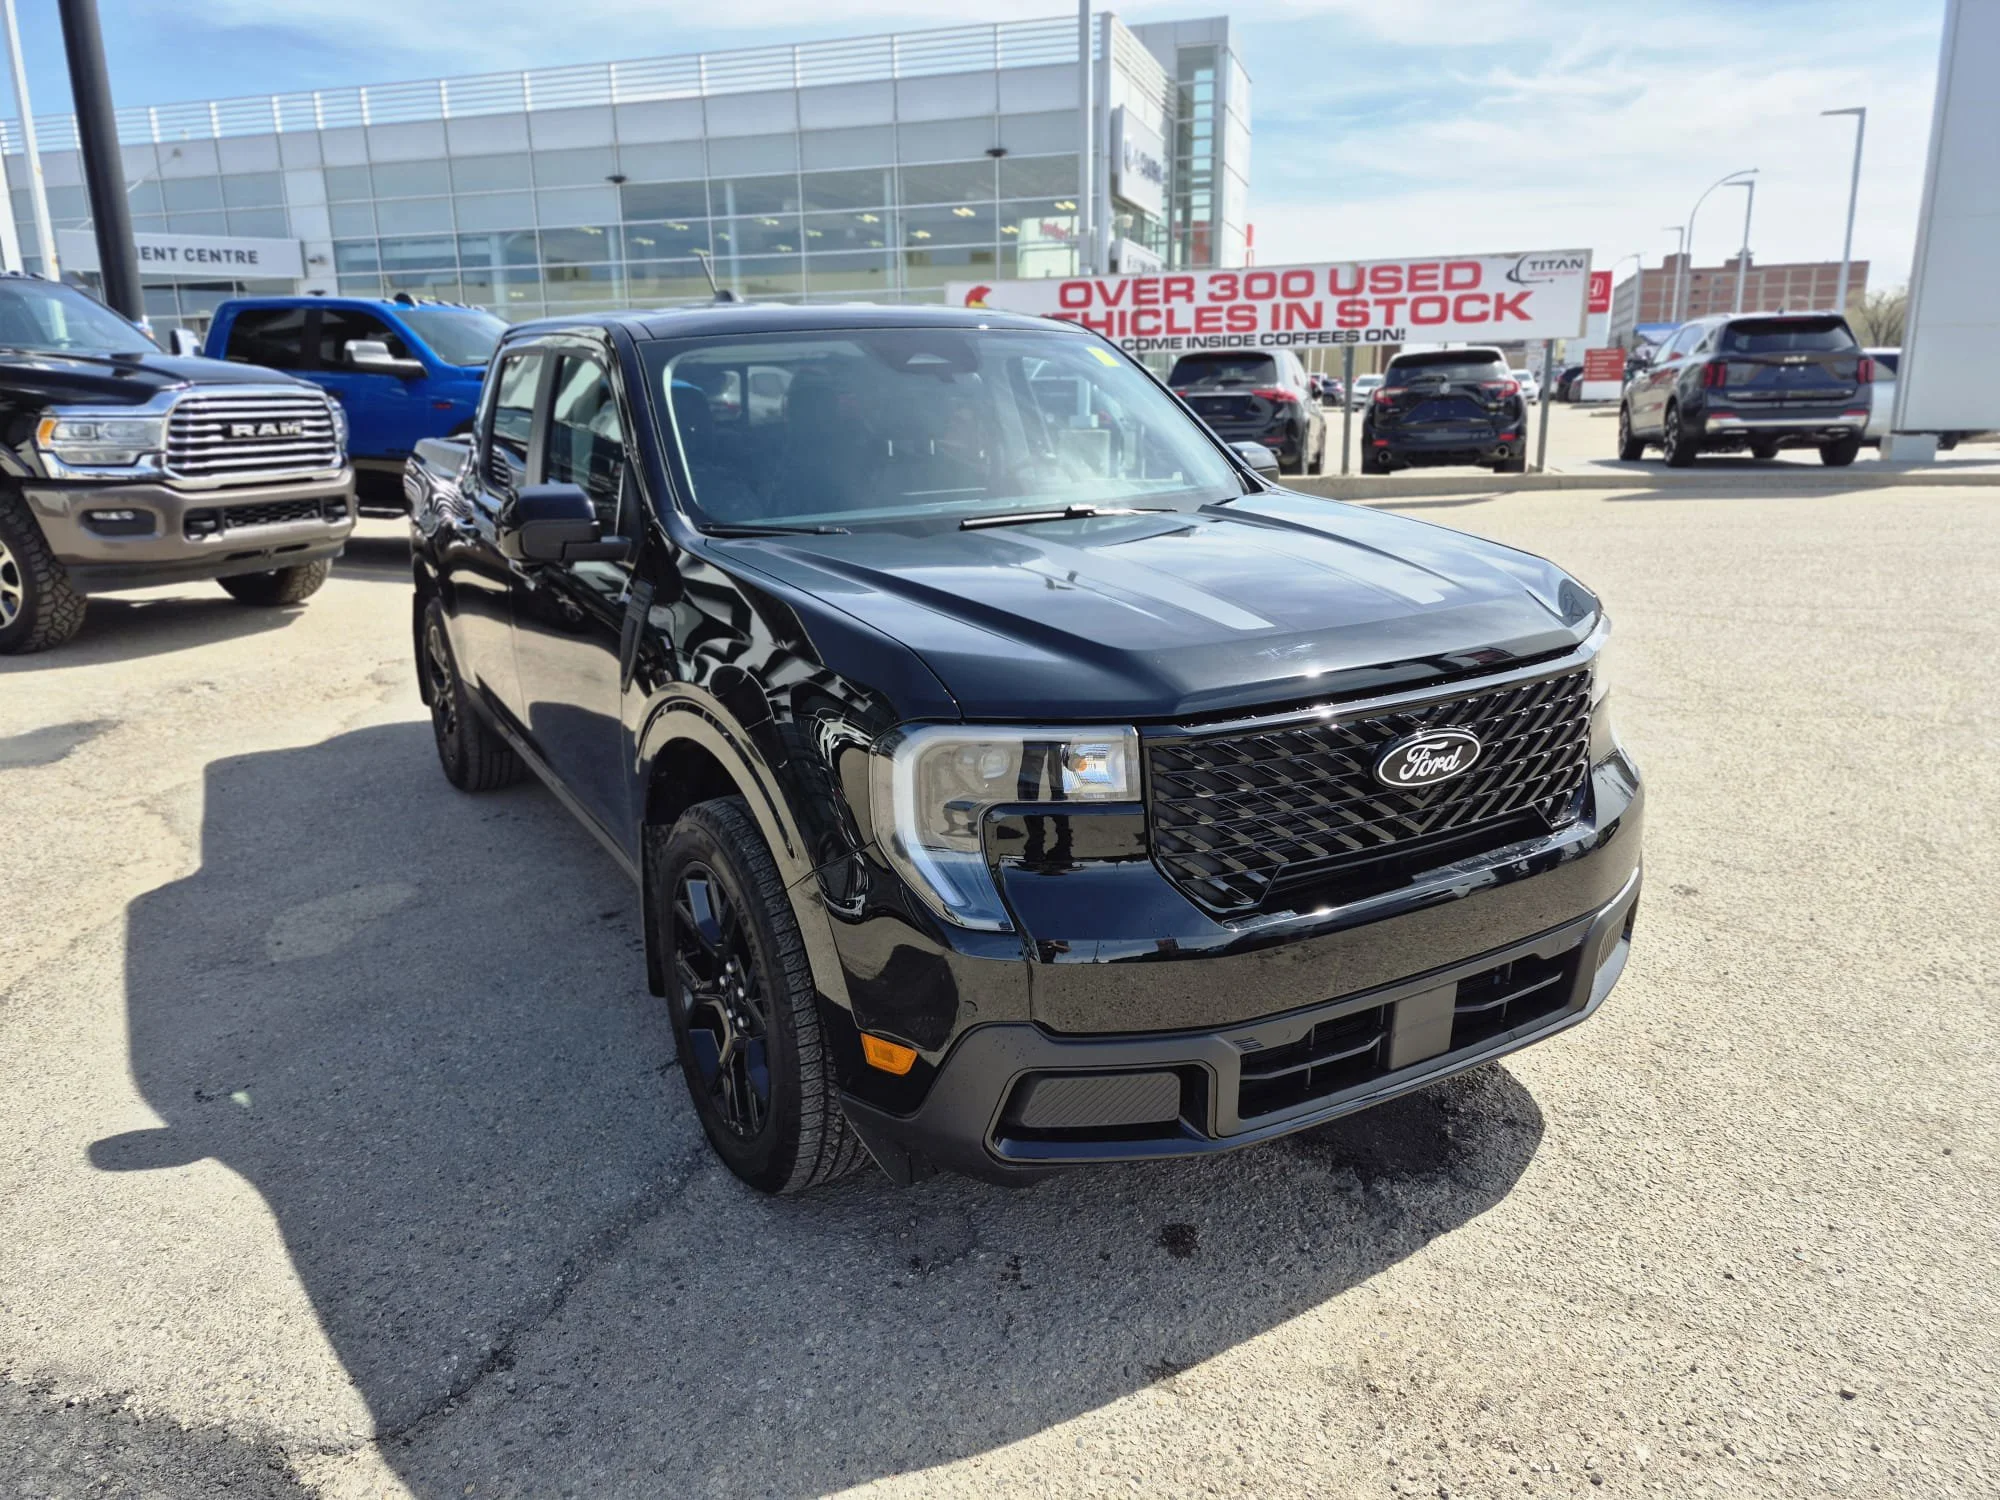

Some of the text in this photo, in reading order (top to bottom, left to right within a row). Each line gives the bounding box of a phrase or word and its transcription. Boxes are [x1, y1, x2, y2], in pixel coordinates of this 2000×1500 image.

[184, 247, 259, 264] CENTRE
[1528, 258, 1583, 270] TITAN
[1059, 261, 1482, 309] OVER 300 USED
[1040, 291, 1533, 337] HICLES IN STOCK
[1121, 327, 1406, 351] COME INSIDE COFFEES ON!
[231, 422, 302, 437] RAM
[1399, 741, 1463, 780] Ford
